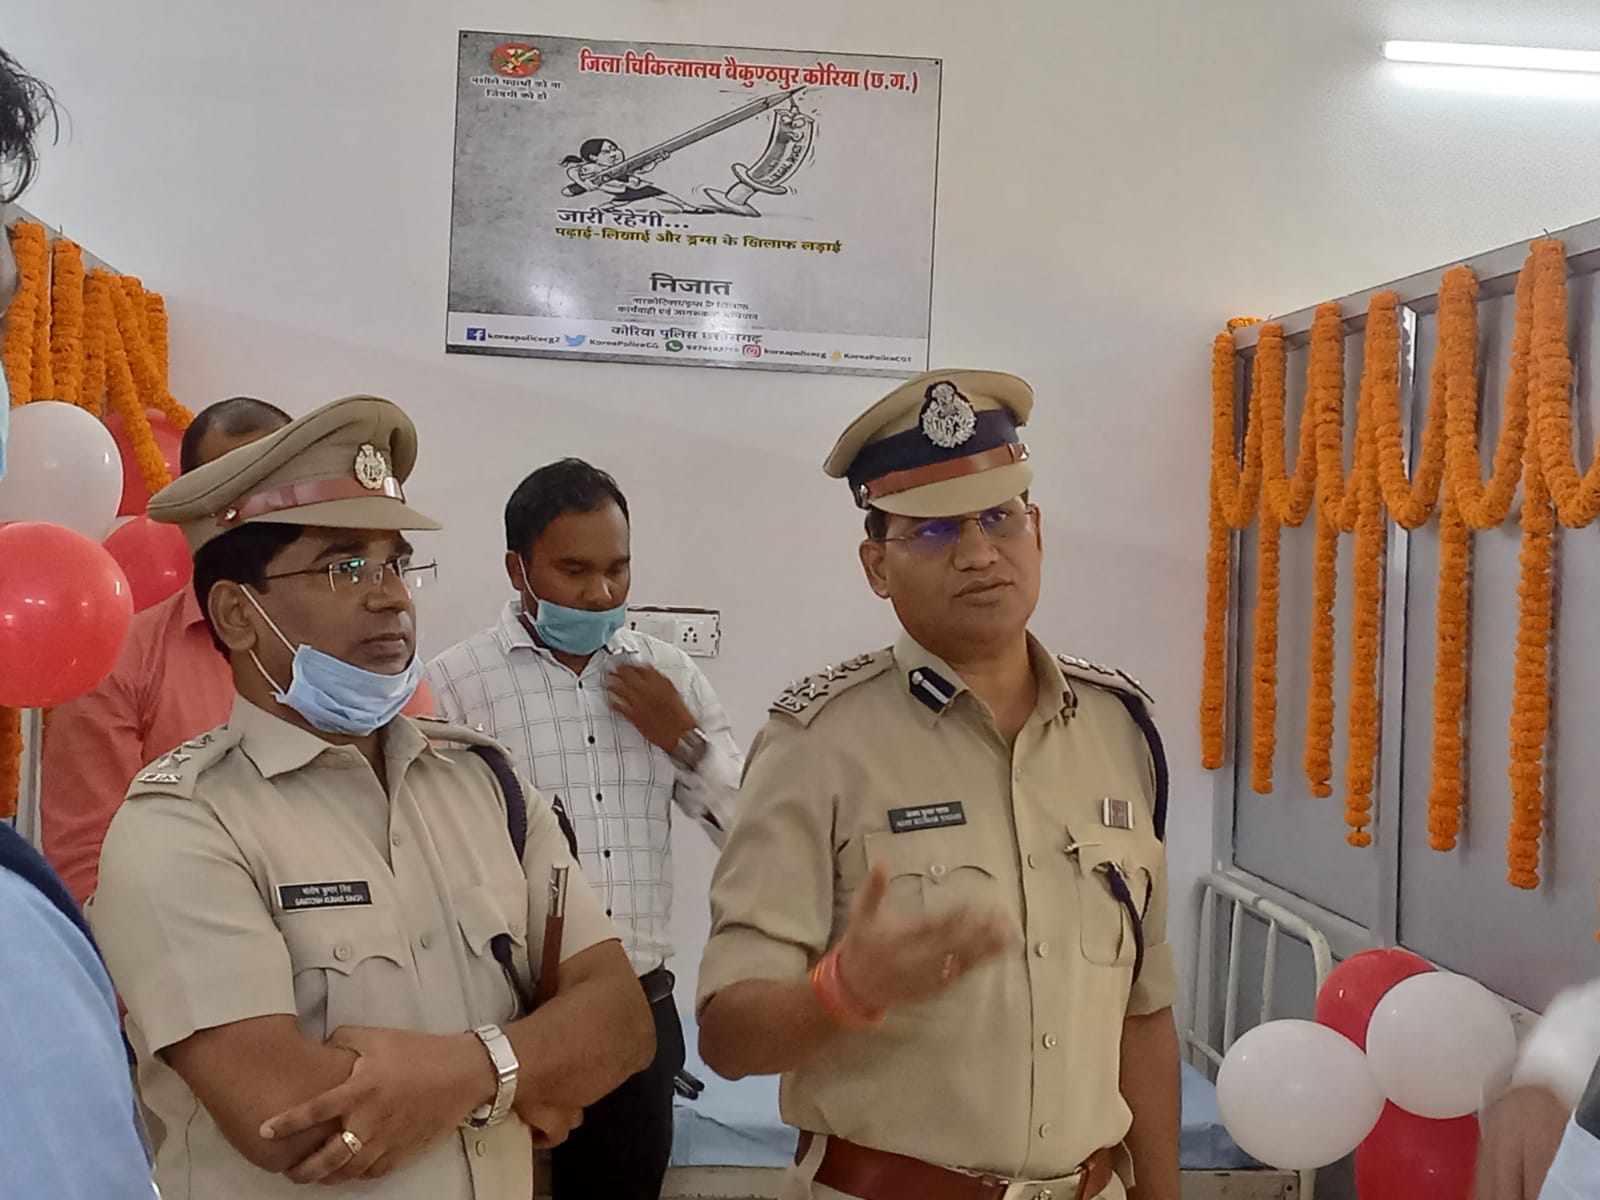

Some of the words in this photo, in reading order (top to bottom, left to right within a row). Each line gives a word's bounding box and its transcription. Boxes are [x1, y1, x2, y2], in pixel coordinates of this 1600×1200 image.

[579, 47, 621, 73] जिला
[625, 51, 722, 79] चिकित्सालय
[802, 61, 860, 88] कोरिया
[864, 69, 919, 94] (छ.ग.)
[557, 207, 603, 224] जारी
[656, 229, 681, 243] और
[722, 233, 738, 246] के
[743, 235, 797, 250] खिलाफ
[801, 240, 842, 254] लड़ाई
[649, 272, 733, 296] निजात
[611, 324, 655, 338] कोरिया
[660, 327, 698, 340] पुलिस
